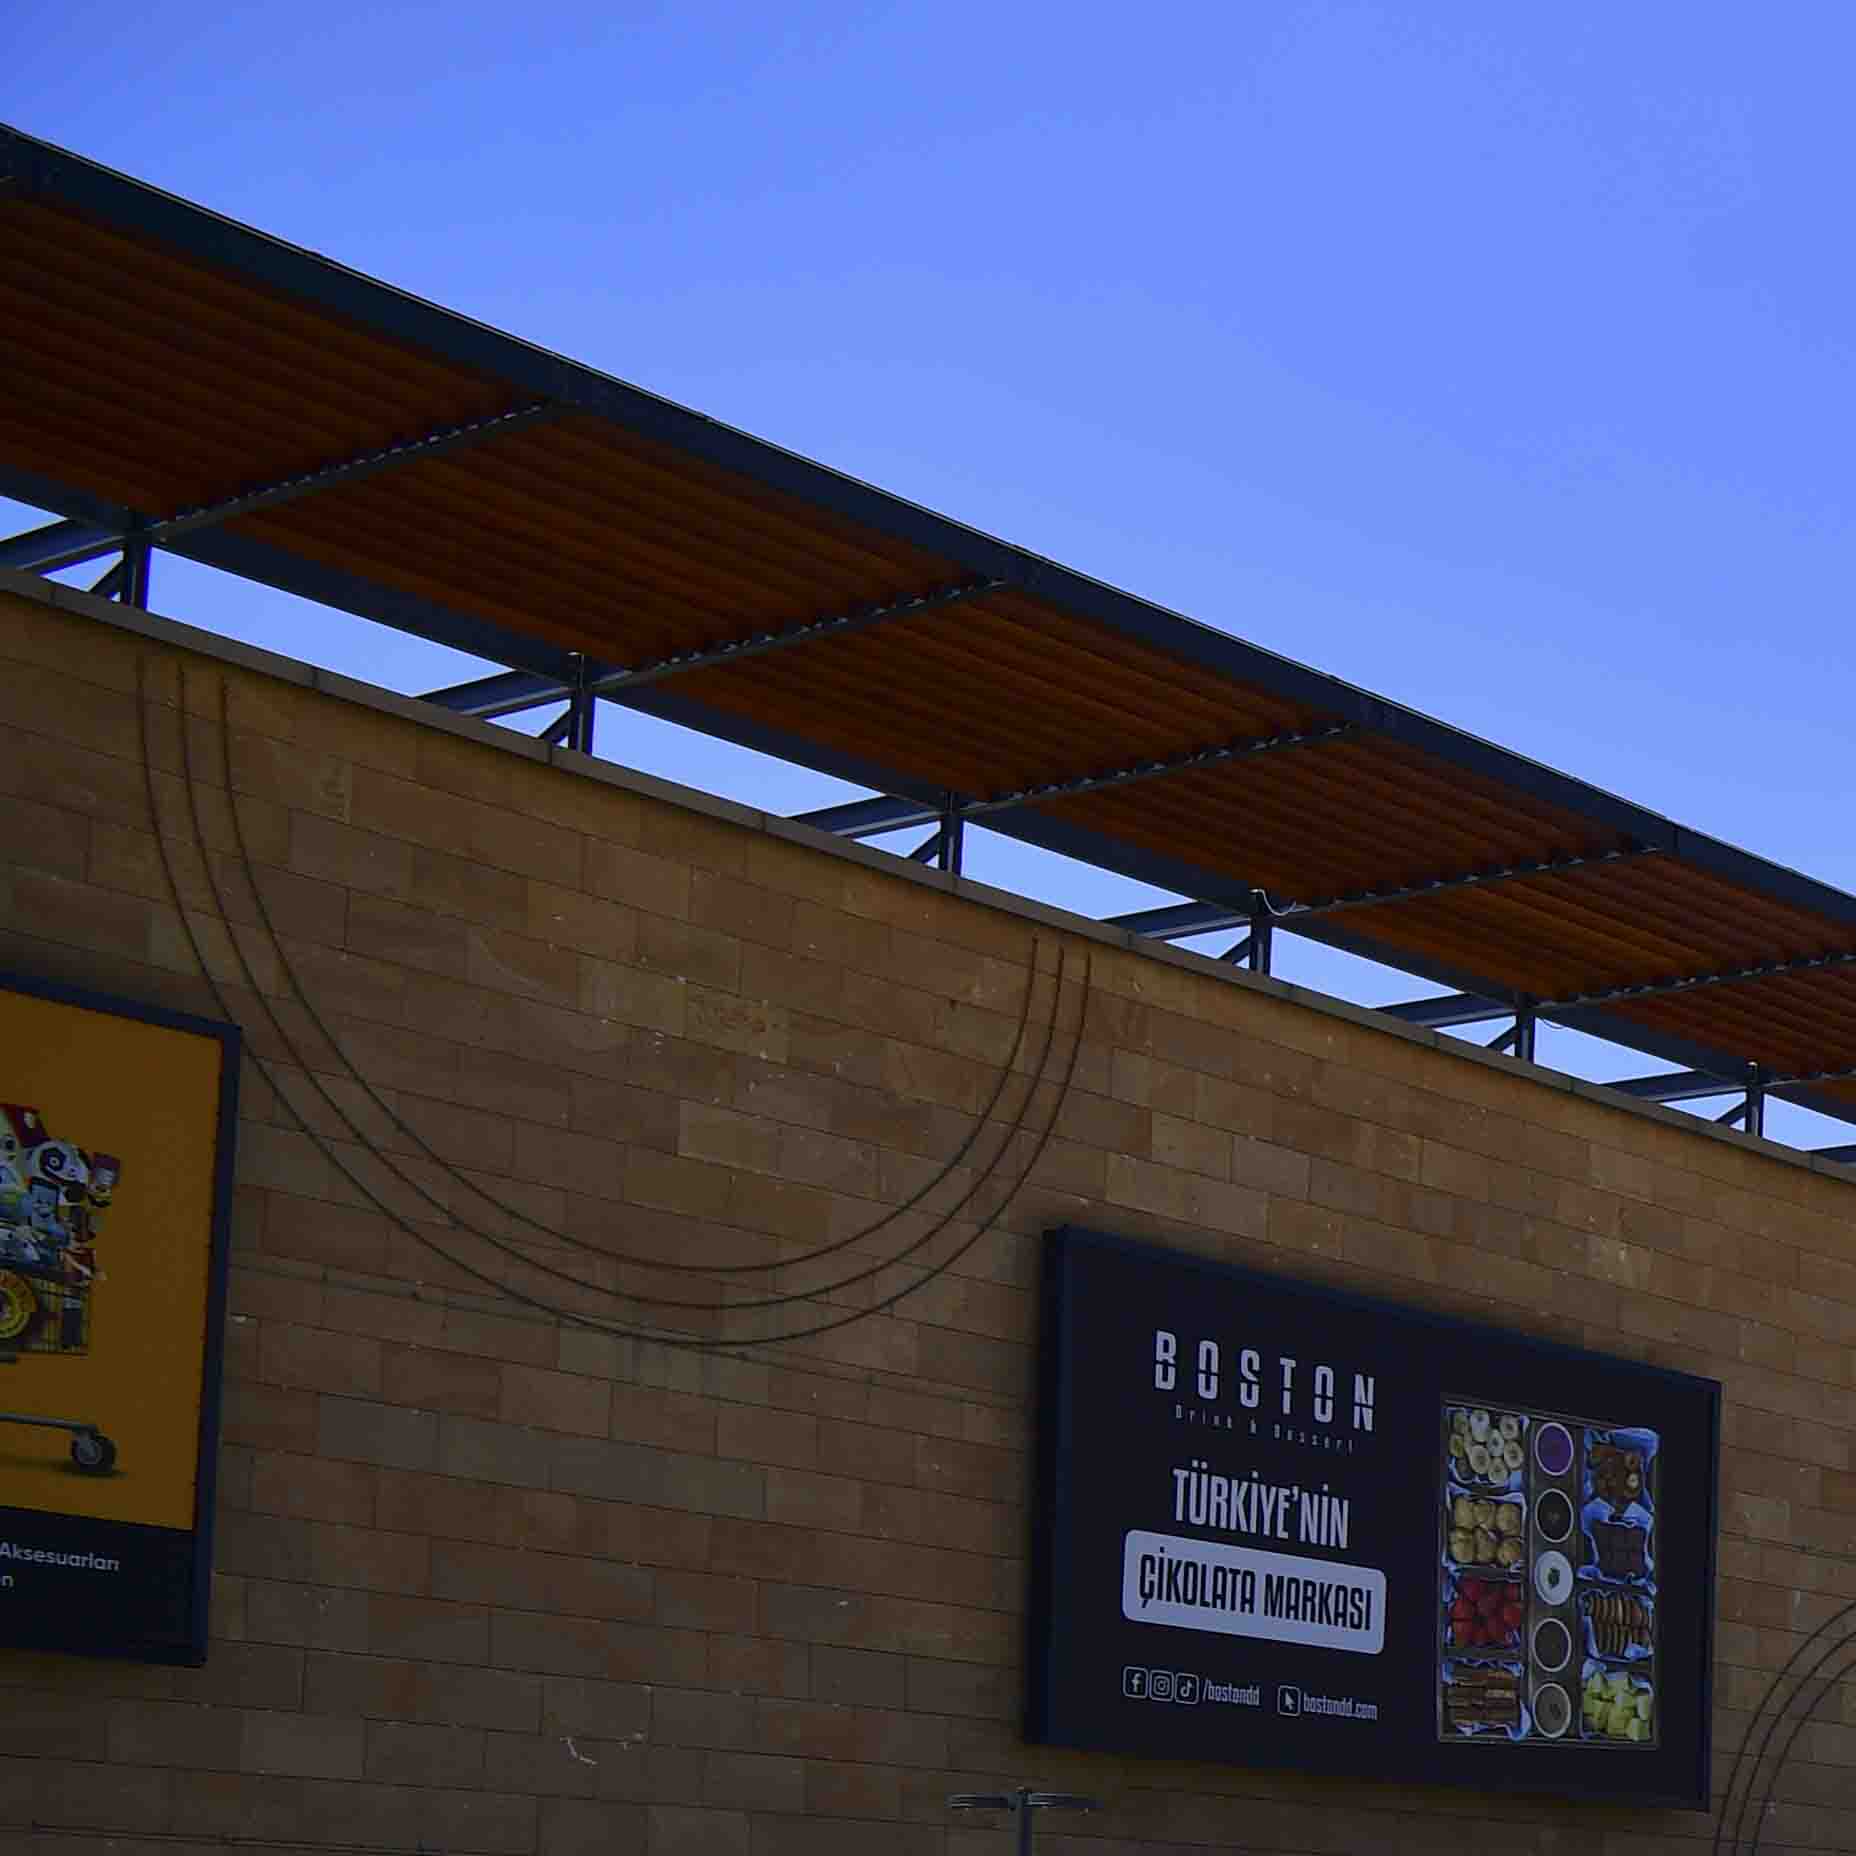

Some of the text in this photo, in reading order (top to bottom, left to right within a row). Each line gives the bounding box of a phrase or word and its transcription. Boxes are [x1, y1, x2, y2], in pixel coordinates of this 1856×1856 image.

[1154, 1329, 1376, 1432] BOSTON
[1139, 1545, 1373, 1632] ÇİKOLATA MARKASI
